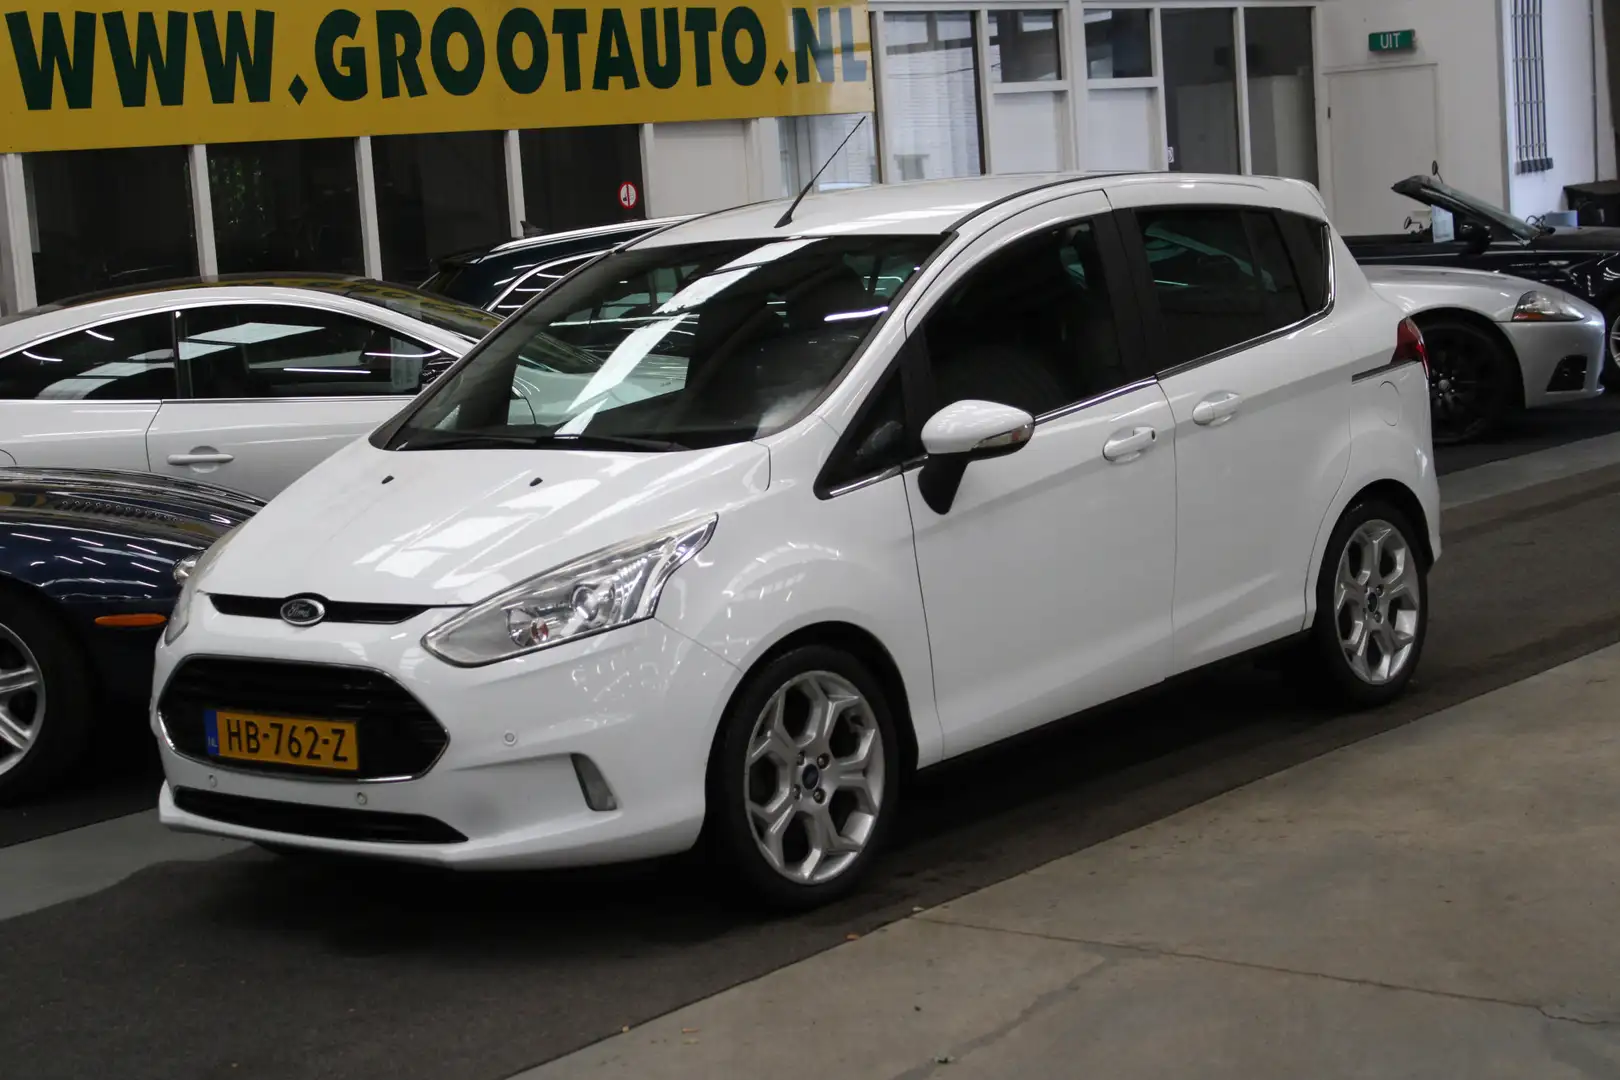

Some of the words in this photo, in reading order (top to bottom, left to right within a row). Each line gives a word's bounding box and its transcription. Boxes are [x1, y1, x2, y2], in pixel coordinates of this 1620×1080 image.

[5, 6, 868, 110] WWW.GROOTAUTO.NL
[1380, 32, 1400, 49] UIT
[226, 718, 349, 762] HB-762-Z
